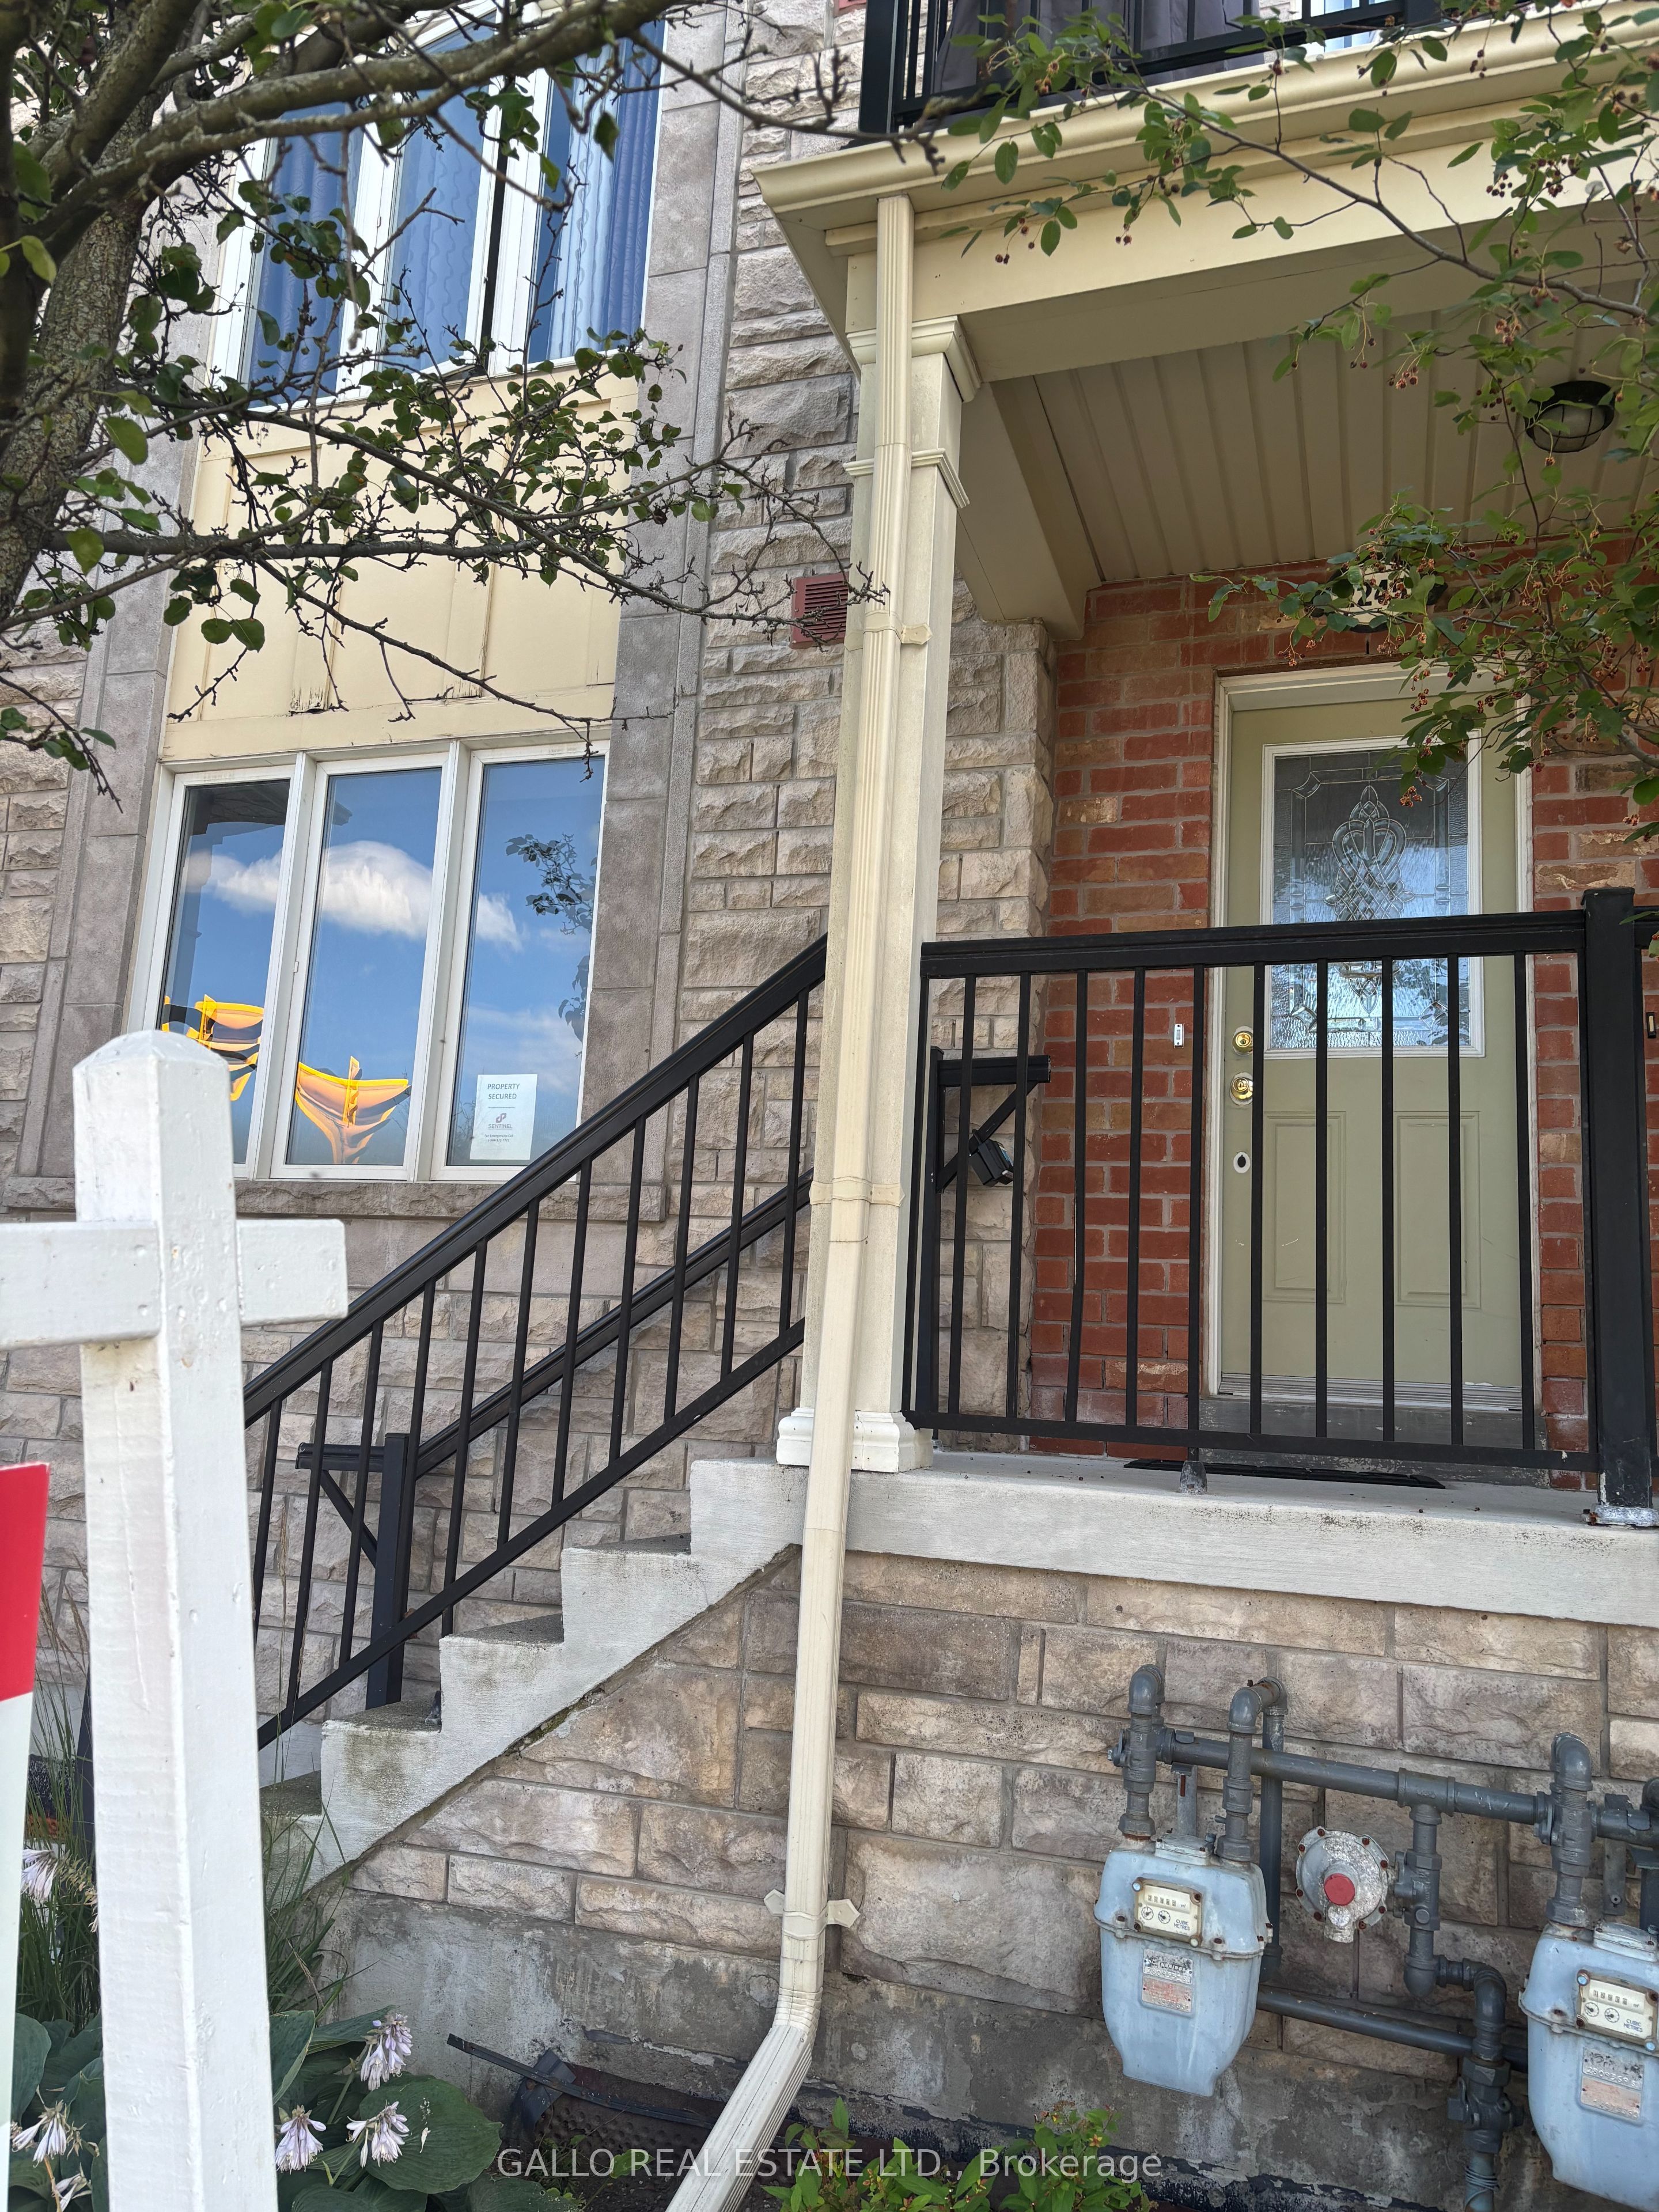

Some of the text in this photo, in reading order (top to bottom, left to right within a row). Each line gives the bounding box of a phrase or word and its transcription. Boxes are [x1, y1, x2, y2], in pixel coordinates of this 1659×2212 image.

[1174, 1922, 1190, 1931] METRES
[1623, 2022, 1643, 2032] METRES
[1626, 2019, 1641, 2027] CUBIC
